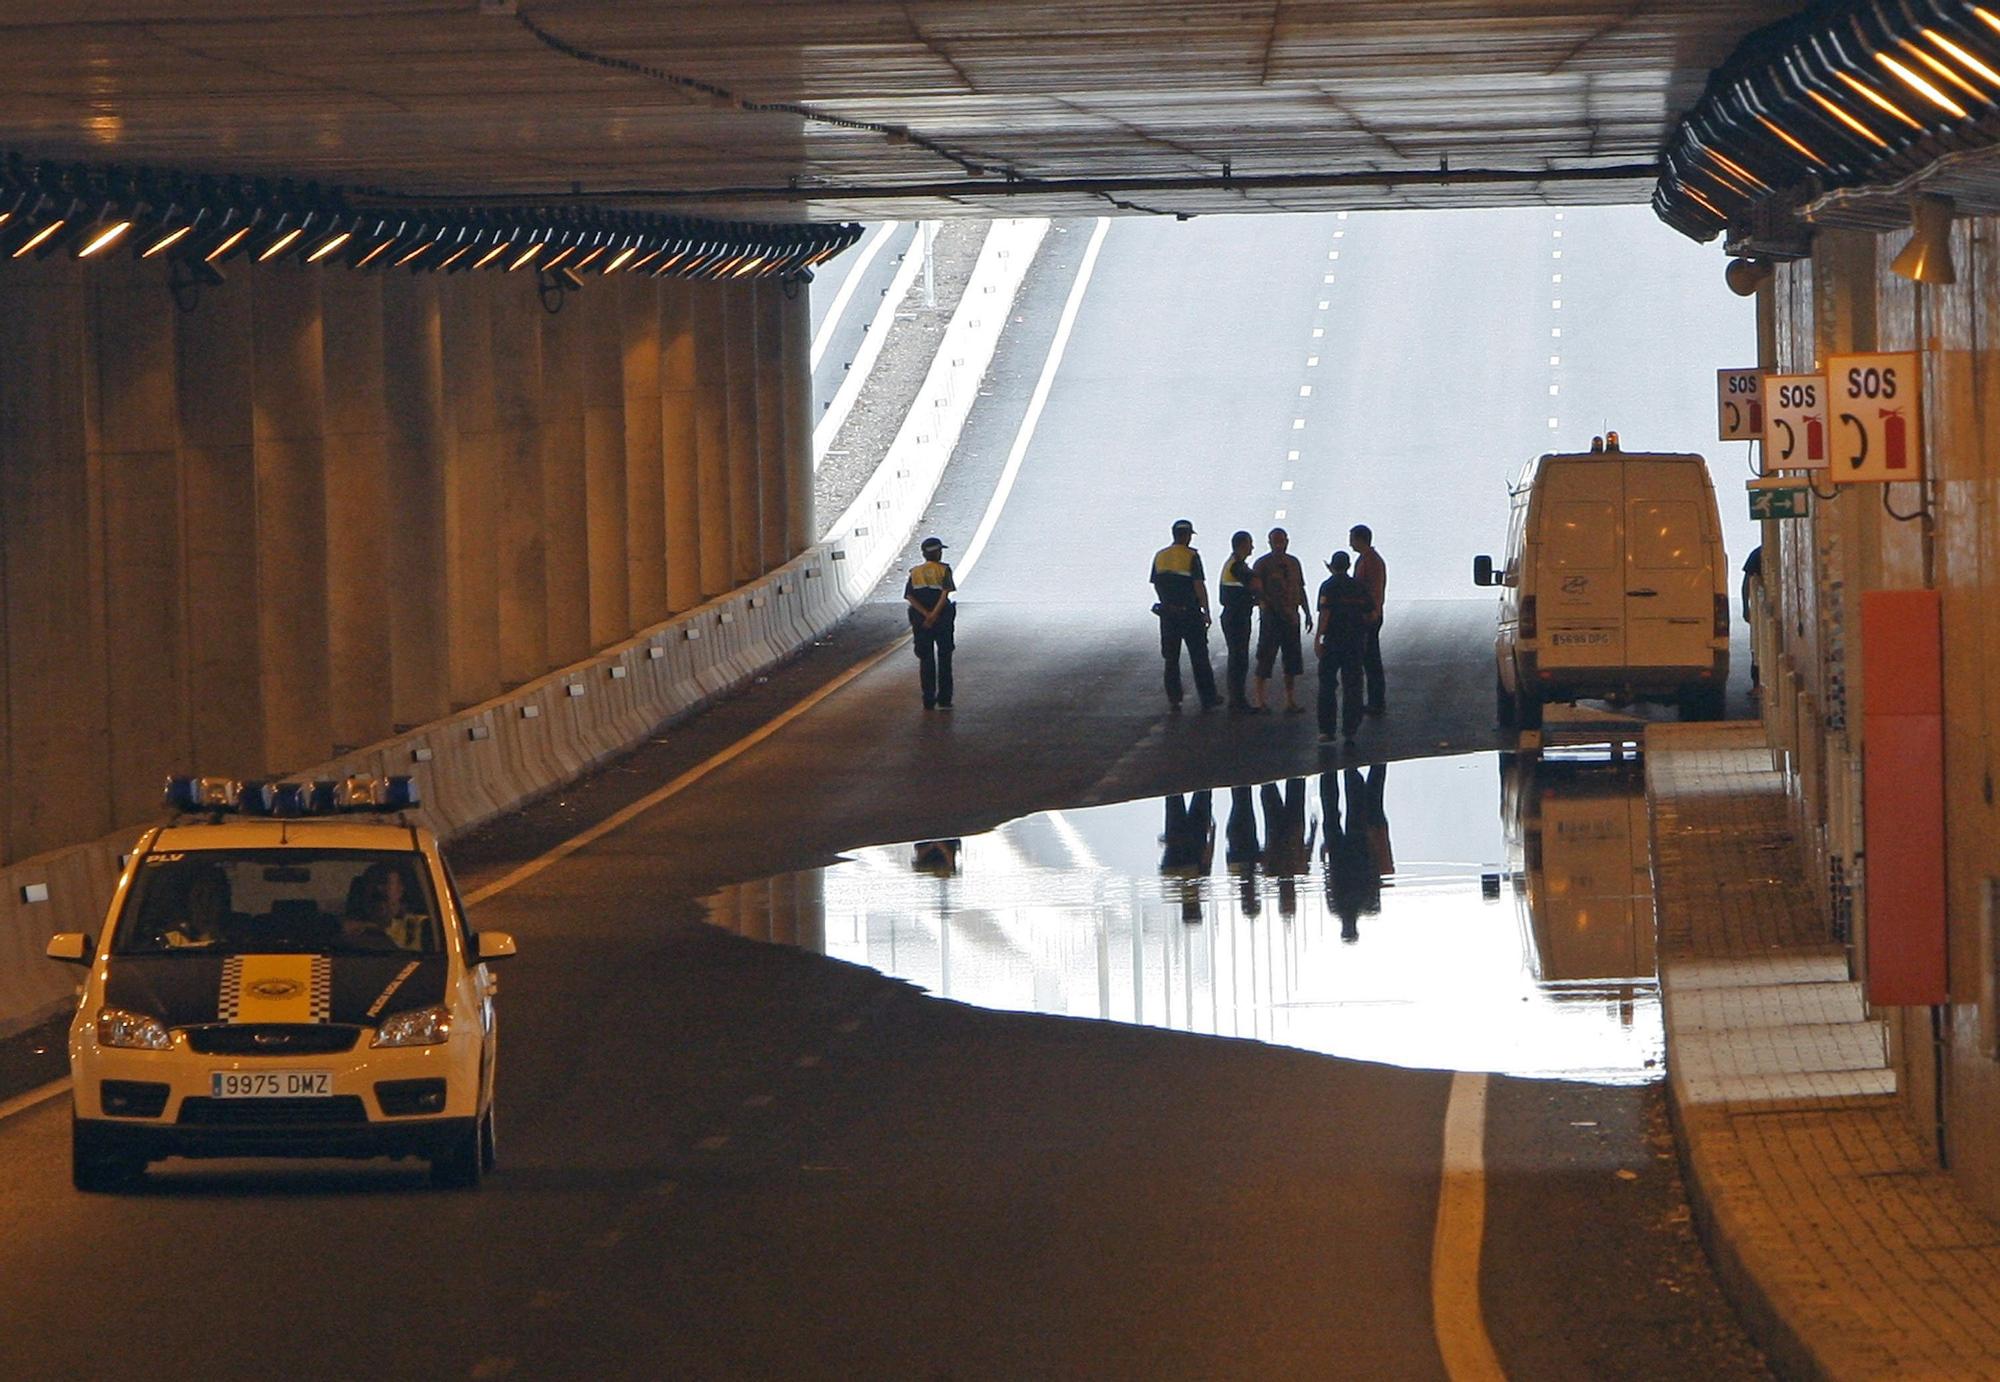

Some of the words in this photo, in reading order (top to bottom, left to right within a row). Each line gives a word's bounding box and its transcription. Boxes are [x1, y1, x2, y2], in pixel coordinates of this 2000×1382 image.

[1729, 376, 1757, 394] SOS
[1848, 367, 1896, 399] SOS
[1780, 385, 1816, 408] SOS
[226, 1075, 280, 1094] 9975
[287, 1074, 327, 1094] DMZ
